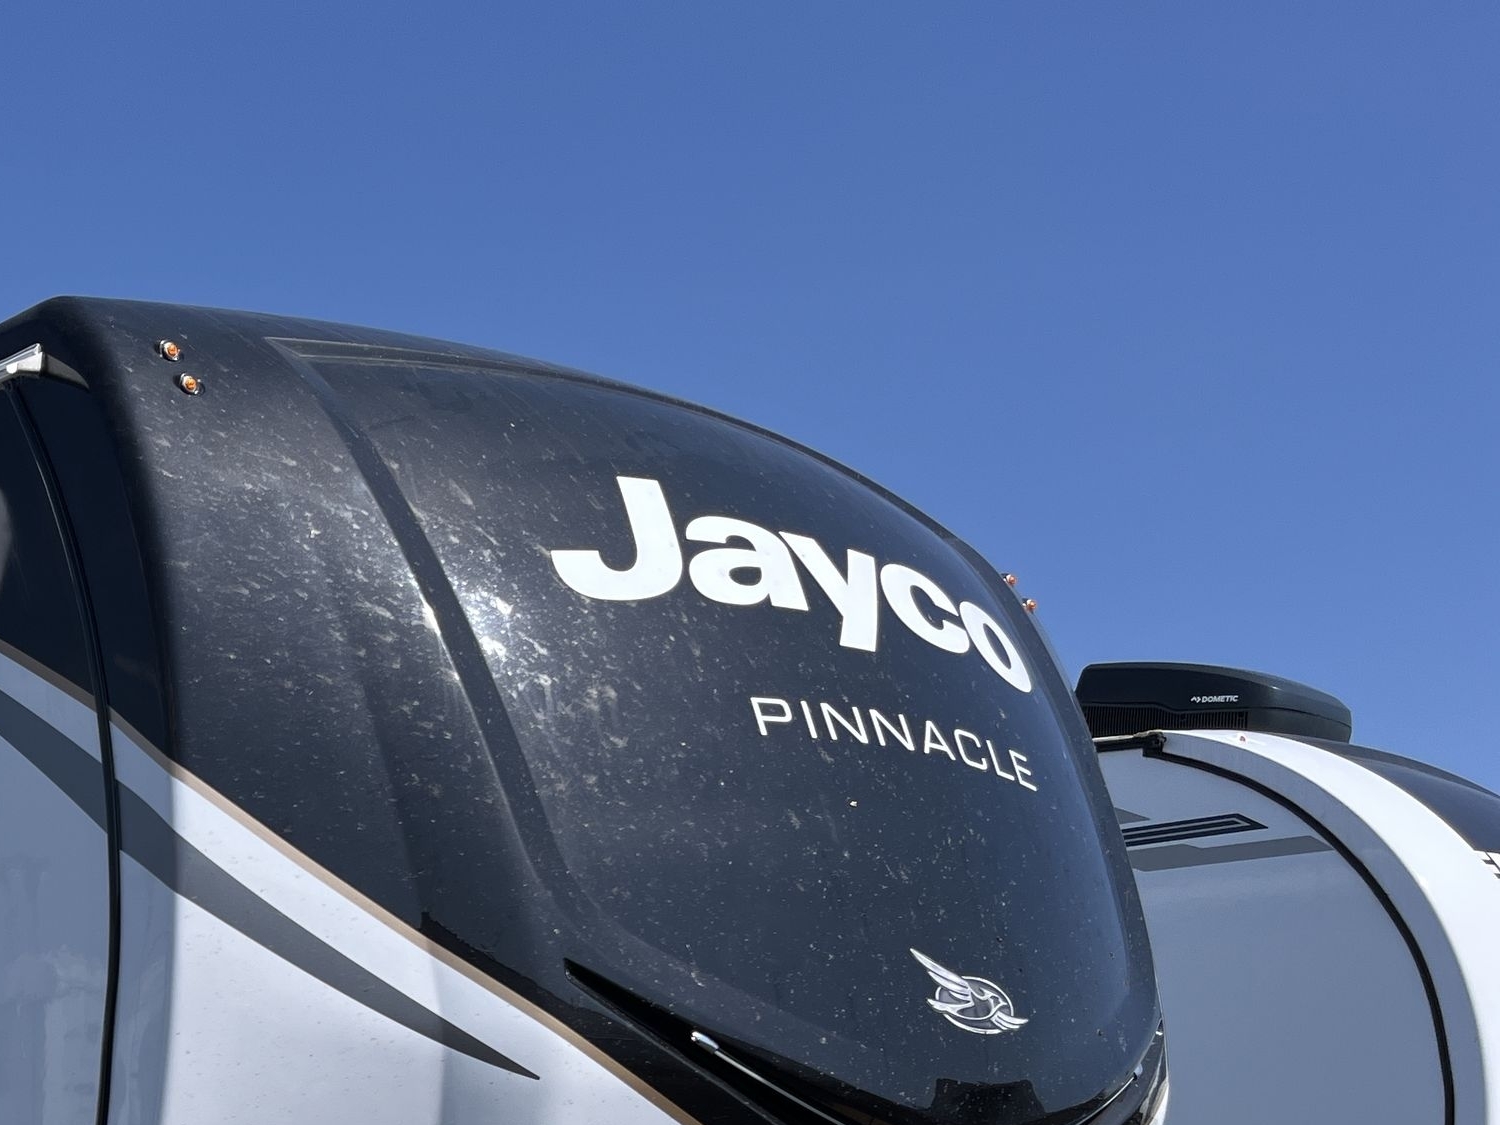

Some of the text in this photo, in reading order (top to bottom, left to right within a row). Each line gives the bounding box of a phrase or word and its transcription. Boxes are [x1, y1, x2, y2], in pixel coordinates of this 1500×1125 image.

[551, 475, 1032, 693] Jayco
[750, 697, 1037, 792] PINNACLE
[1201, 694, 1239, 703] DOMETIC
